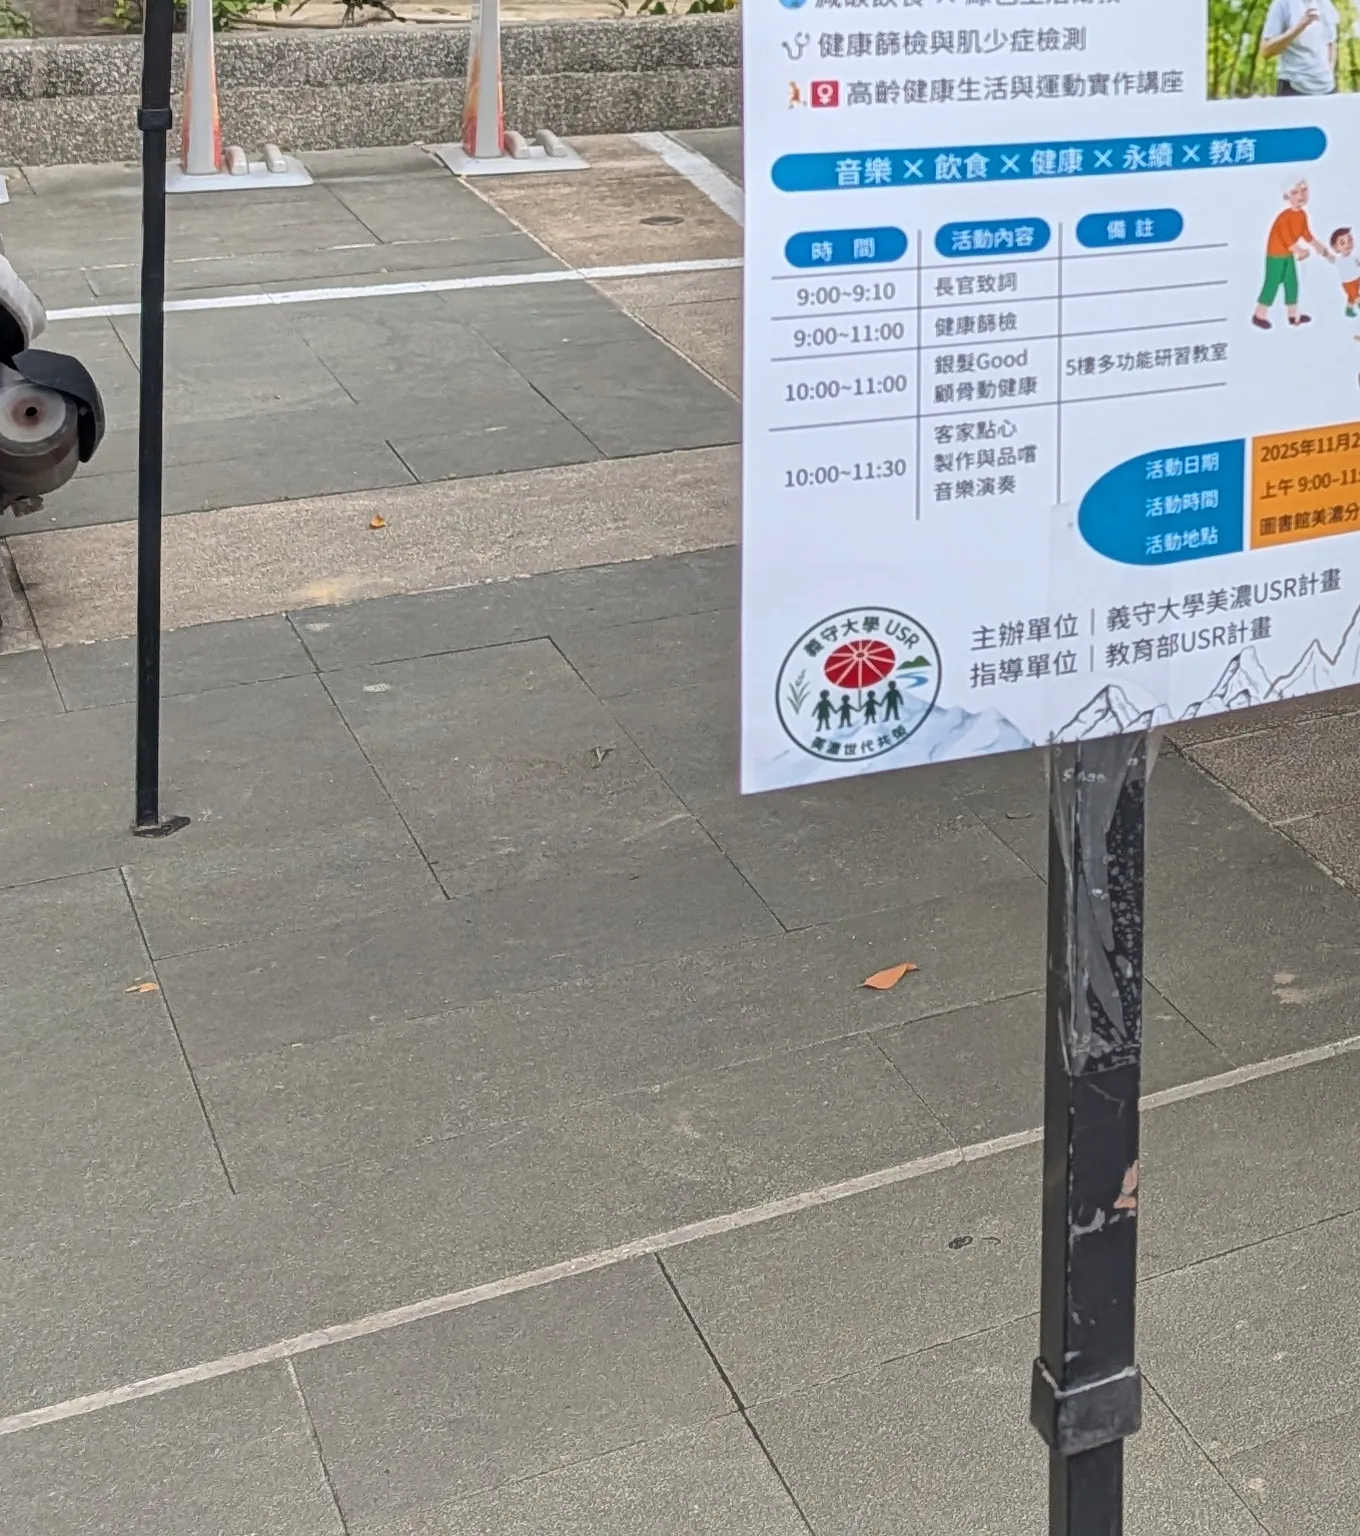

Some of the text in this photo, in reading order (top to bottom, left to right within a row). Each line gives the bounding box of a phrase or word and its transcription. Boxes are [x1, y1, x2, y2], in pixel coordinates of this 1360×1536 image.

[818, 25, 1087, 58] 健康篩檢與肌少症檢測
[846, 68, 1185, 108] 高齡健康生活與運動實作講座
[836, 157, 892, 186] 音樂
[934, 152, 990, 183] 飲食
[1031, 146, 1084, 176] 健康
[1122, 142, 1174, 172] 永續
[1209, 136, 1257, 166] 教育
[951, 226, 1036, 251] 活動內容
[796, 282, 896, 306] 9:00~9:10
[934, 273, 1017, 297] 長官致詞
[793, 322, 905, 348] 9:00~11:00
[934, 313, 1017, 338] 健康篩檢
[934, 349, 1028, 376] 銀髮Good
[1065, 342, 1229, 377] 5樓多功能研習教室
[784, 375, 908, 402] 10:00~11:00
[933, 420, 1017, 445] 客家點心
[784, 459, 907, 488] 10:00~11:30
[1145, 452, 1219, 481] 活動日期
[934, 475, 1016, 502] 音樂演奏
[1260, 478, 1294, 500] 上午
[1145, 489, 1218, 518] 活動時間
[1145, 525, 1218, 555] 活動地點
[885, 619, 920, 649] USR
